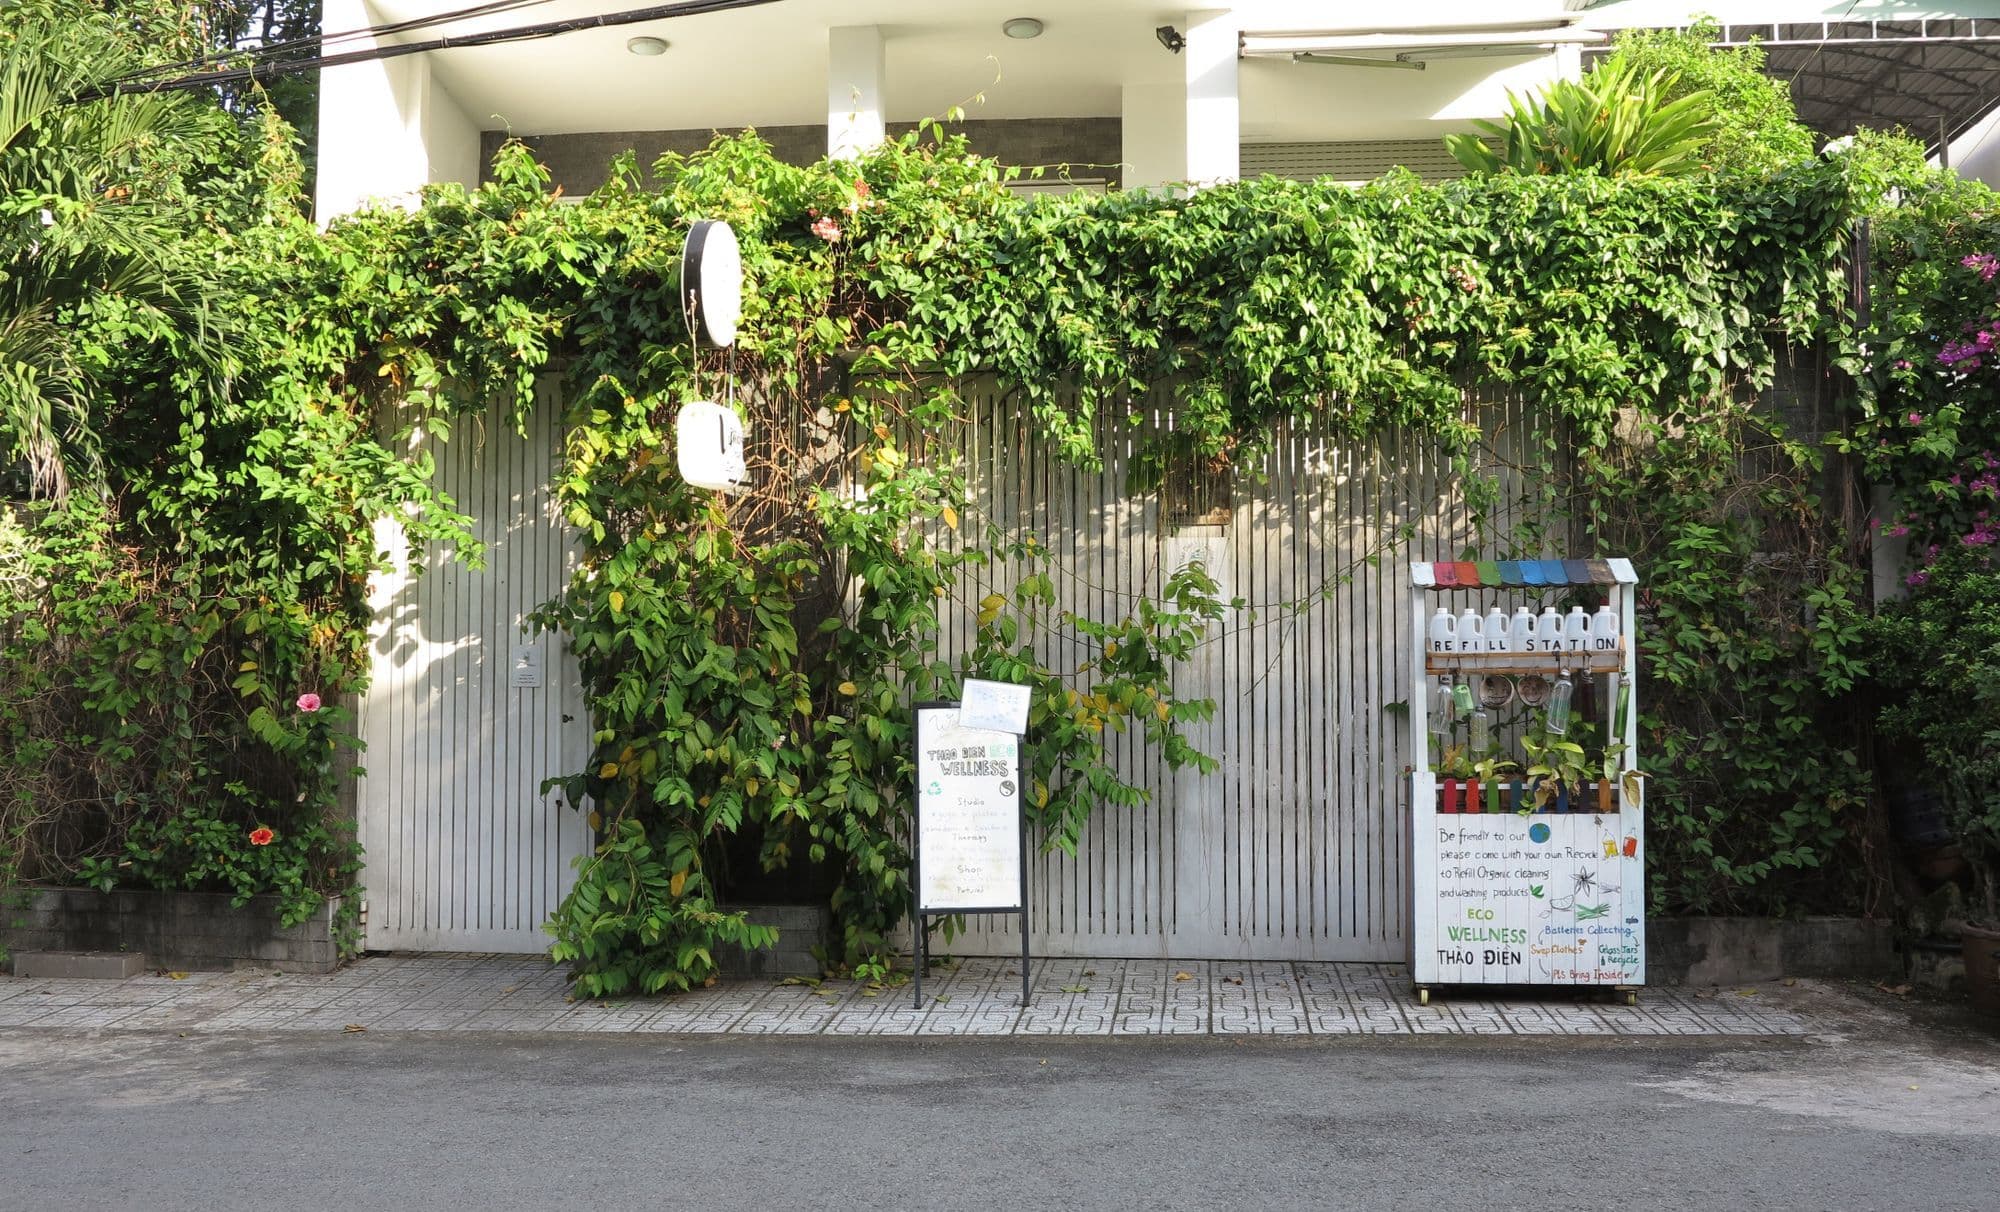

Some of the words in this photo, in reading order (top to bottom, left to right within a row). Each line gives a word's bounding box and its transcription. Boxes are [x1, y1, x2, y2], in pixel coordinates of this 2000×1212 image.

[1435, 639, 1507, 651] REFILL
[1526, 638, 1615, 651] STATION
[940, 760, 1009, 777] WELLNESS
[1439, 828, 1455, 843] Be
[1459, 828, 1490, 845] friendly
[1494, 832, 1505, 841] to
[1509, 833, 1526, 841] our
[1440, 849, 1471, 861] please
[1502, 848, 1521, 859] with
[1525, 851, 1541, 860] your
[957, 864, 984, 876] Shop
[1440, 870, 1452, 879] to
[1453, 866, 1475, 879] Refill
[1477, 865, 1511, 880] Organic
[1515, 868, 1550, 880] cleaning
[1493, 887, 1529, 899] products
[1467, 908, 1494, 920] ECO
[1448, 926, 1527, 944] WELLNESS
[1588, 925, 1634, 937] Collecting
[1608, 956, 1639, 967] Recycle
[1569, 969, 1590, 981] Bring
[1594, 969, 1623, 979] Inside
